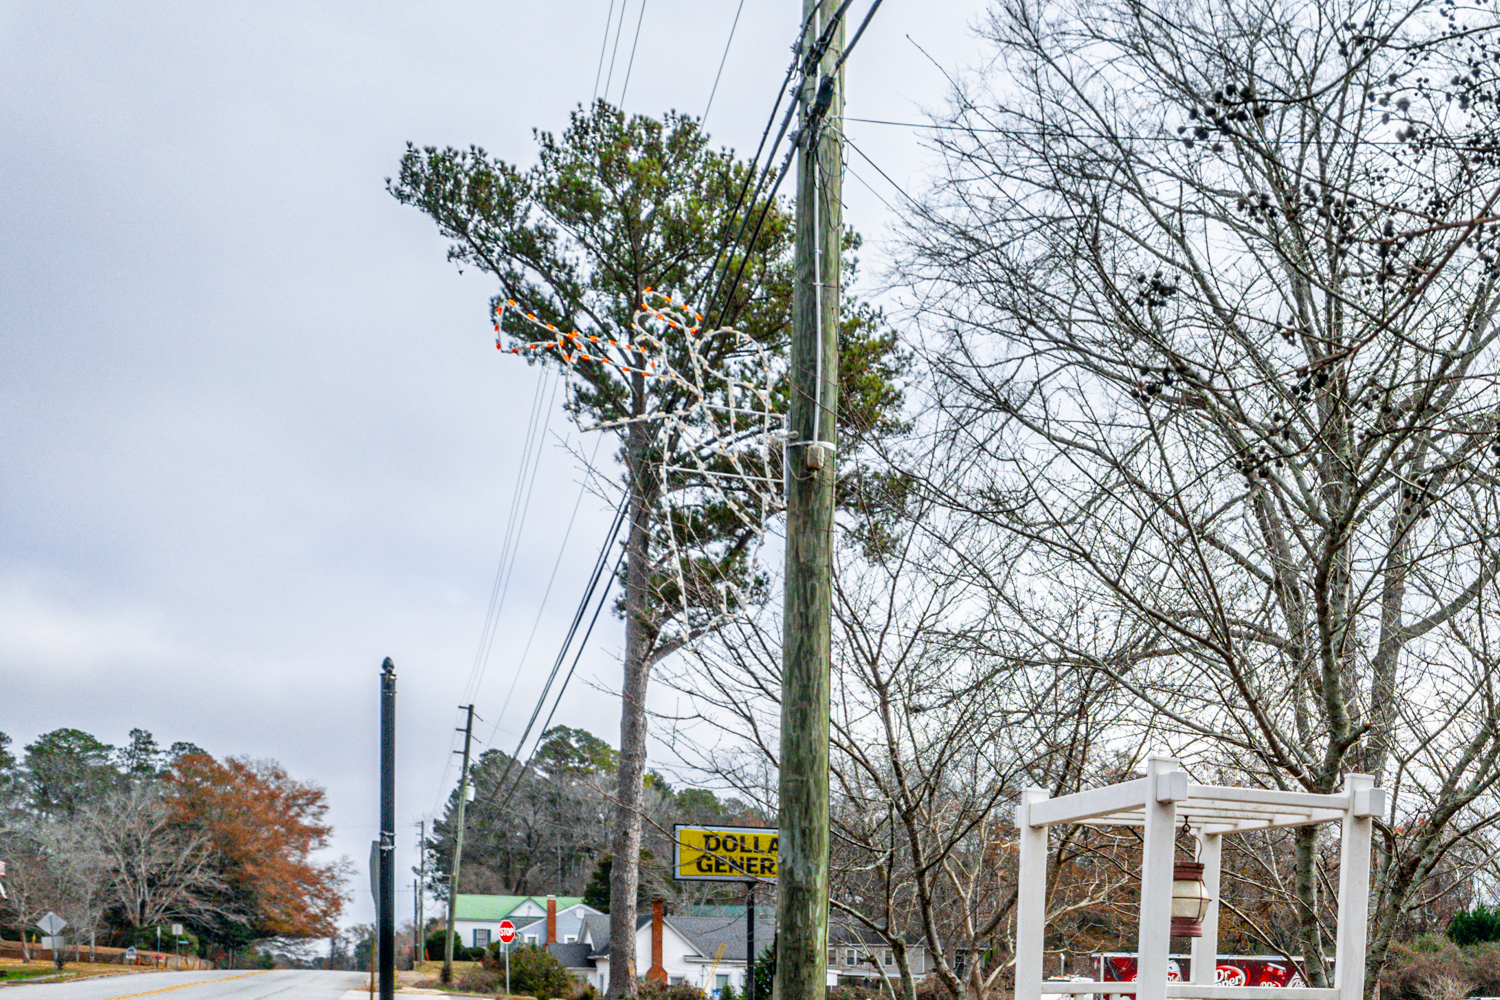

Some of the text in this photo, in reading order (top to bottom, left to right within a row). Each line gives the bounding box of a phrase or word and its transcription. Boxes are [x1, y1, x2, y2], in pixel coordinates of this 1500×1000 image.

[696, 854, 776, 875] GENER
[499, 928, 514, 936] STOP
[1215, 969, 1231, 981] Dr
